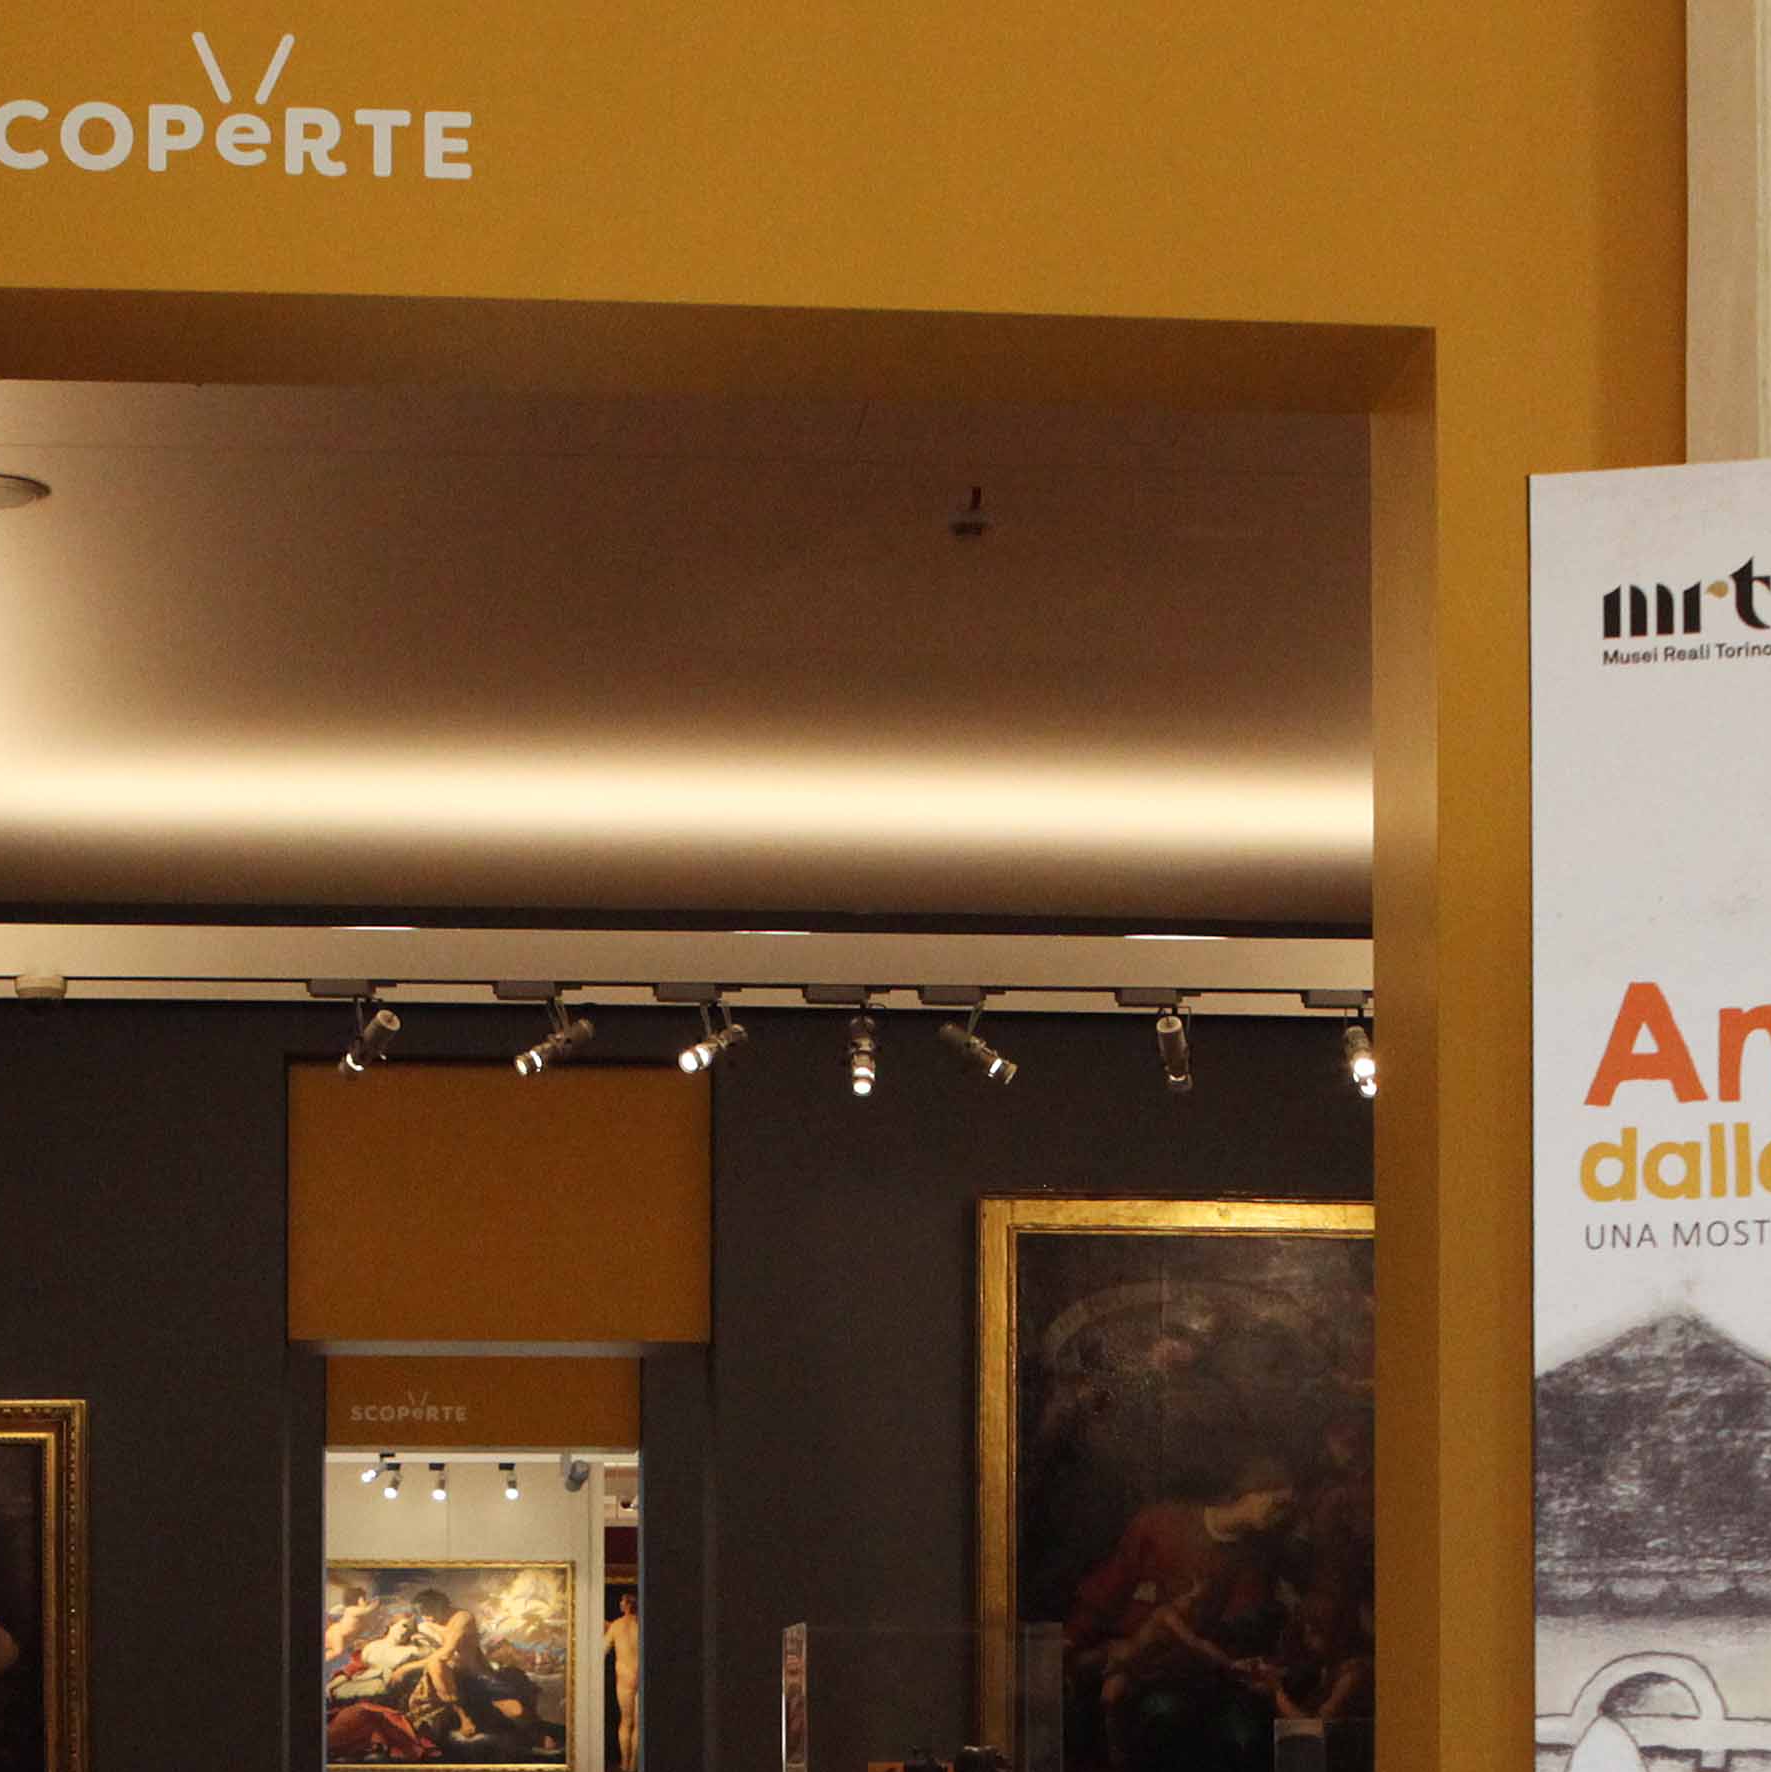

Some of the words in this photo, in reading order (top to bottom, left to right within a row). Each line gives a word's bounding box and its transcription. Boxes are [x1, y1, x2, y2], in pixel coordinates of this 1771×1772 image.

[1603, 648, 1658, 664] Musei
[1664, 644, 1710, 661] Reali
[1586, 1224, 1657, 1250] UNA
